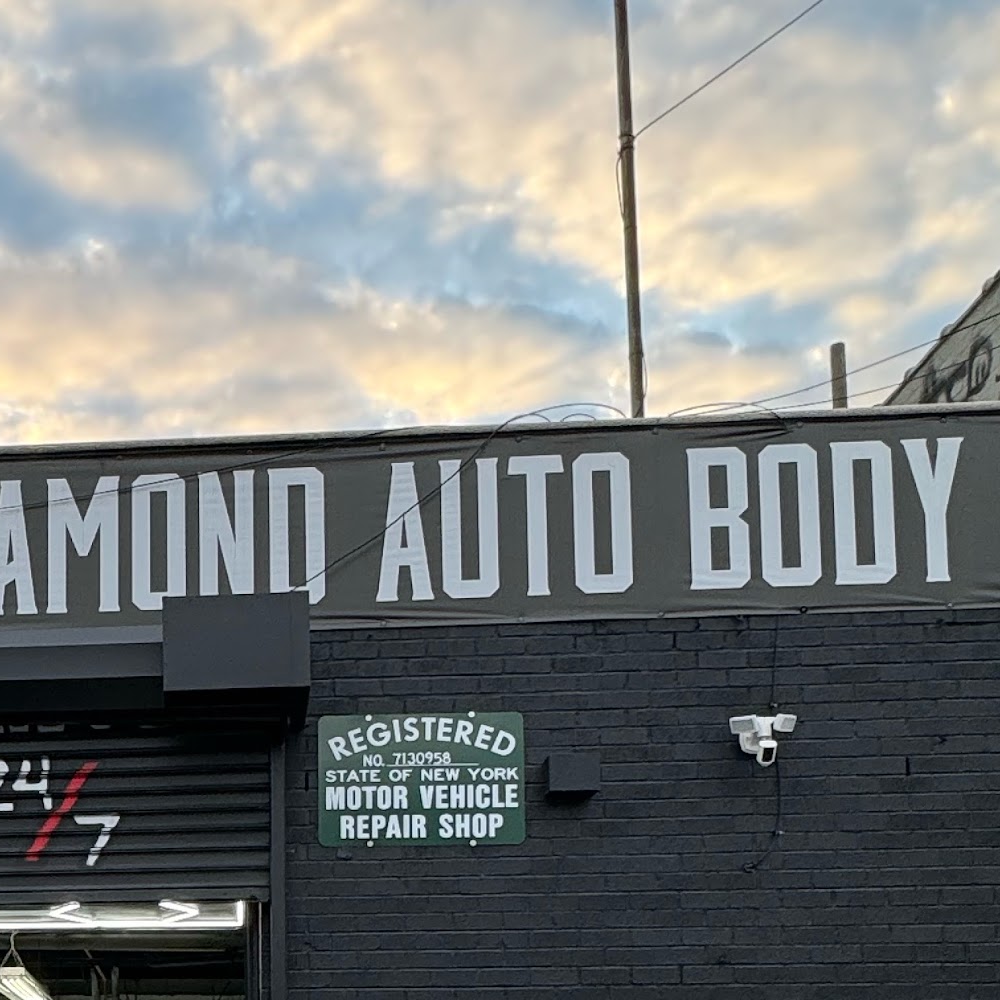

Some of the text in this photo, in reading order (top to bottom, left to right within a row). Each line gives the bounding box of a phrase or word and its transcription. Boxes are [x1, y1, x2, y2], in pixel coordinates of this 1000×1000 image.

[376, 451, 634, 602] AUTO
[686, 436, 965, 590] BODY
[328, 717, 516, 761] REGISTERED
[362, 752, 452, 767] NO. 7130958
[325, 767, 519, 783] STATE OF NEW YORK
[325, 784, 519, 811] MOTOR VEHICLE
[340, 813, 504, 840] REPAIR SHOP
